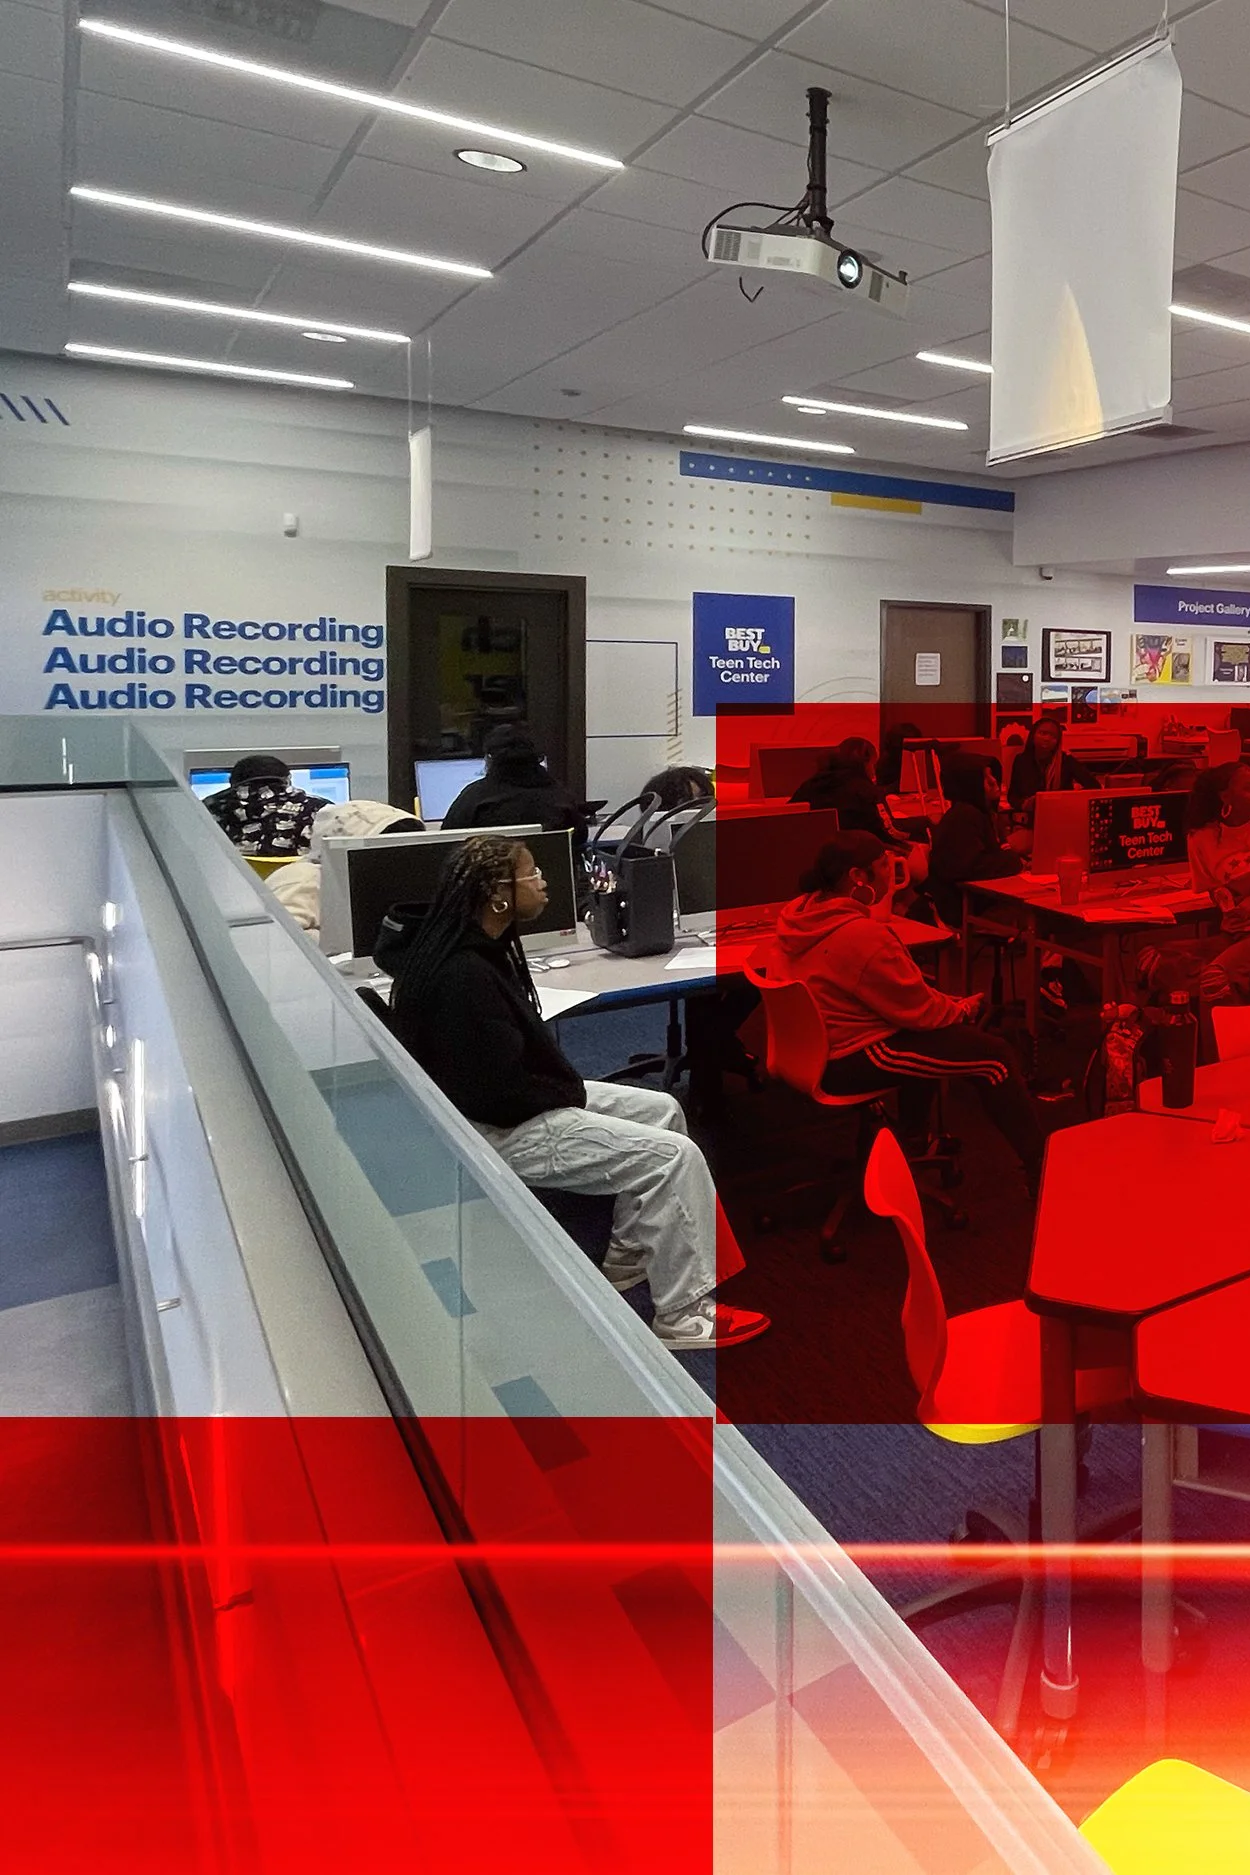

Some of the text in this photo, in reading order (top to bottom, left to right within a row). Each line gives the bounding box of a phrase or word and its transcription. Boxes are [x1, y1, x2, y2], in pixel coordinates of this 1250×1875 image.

[42, 588, 121, 606] activity
[1178, 600, 1250, 617] Project Gallery
[42, 609, 384, 649] Audio Recording
[725, 627, 765, 640] BEST
[728, 640, 762, 652] BUY
[43, 647, 385, 682] Audio Recording
[709, 656, 780, 669] Teen Tech
[720, 671, 770, 683] Center
[44, 683, 385, 713] Audio Recording
[1131, 804, 1161, 818] BEST
[1133, 817, 1158, 829] BUY
[1119, 831, 1173, 847] Teen Tech
[1127, 847, 1164, 859] Center
